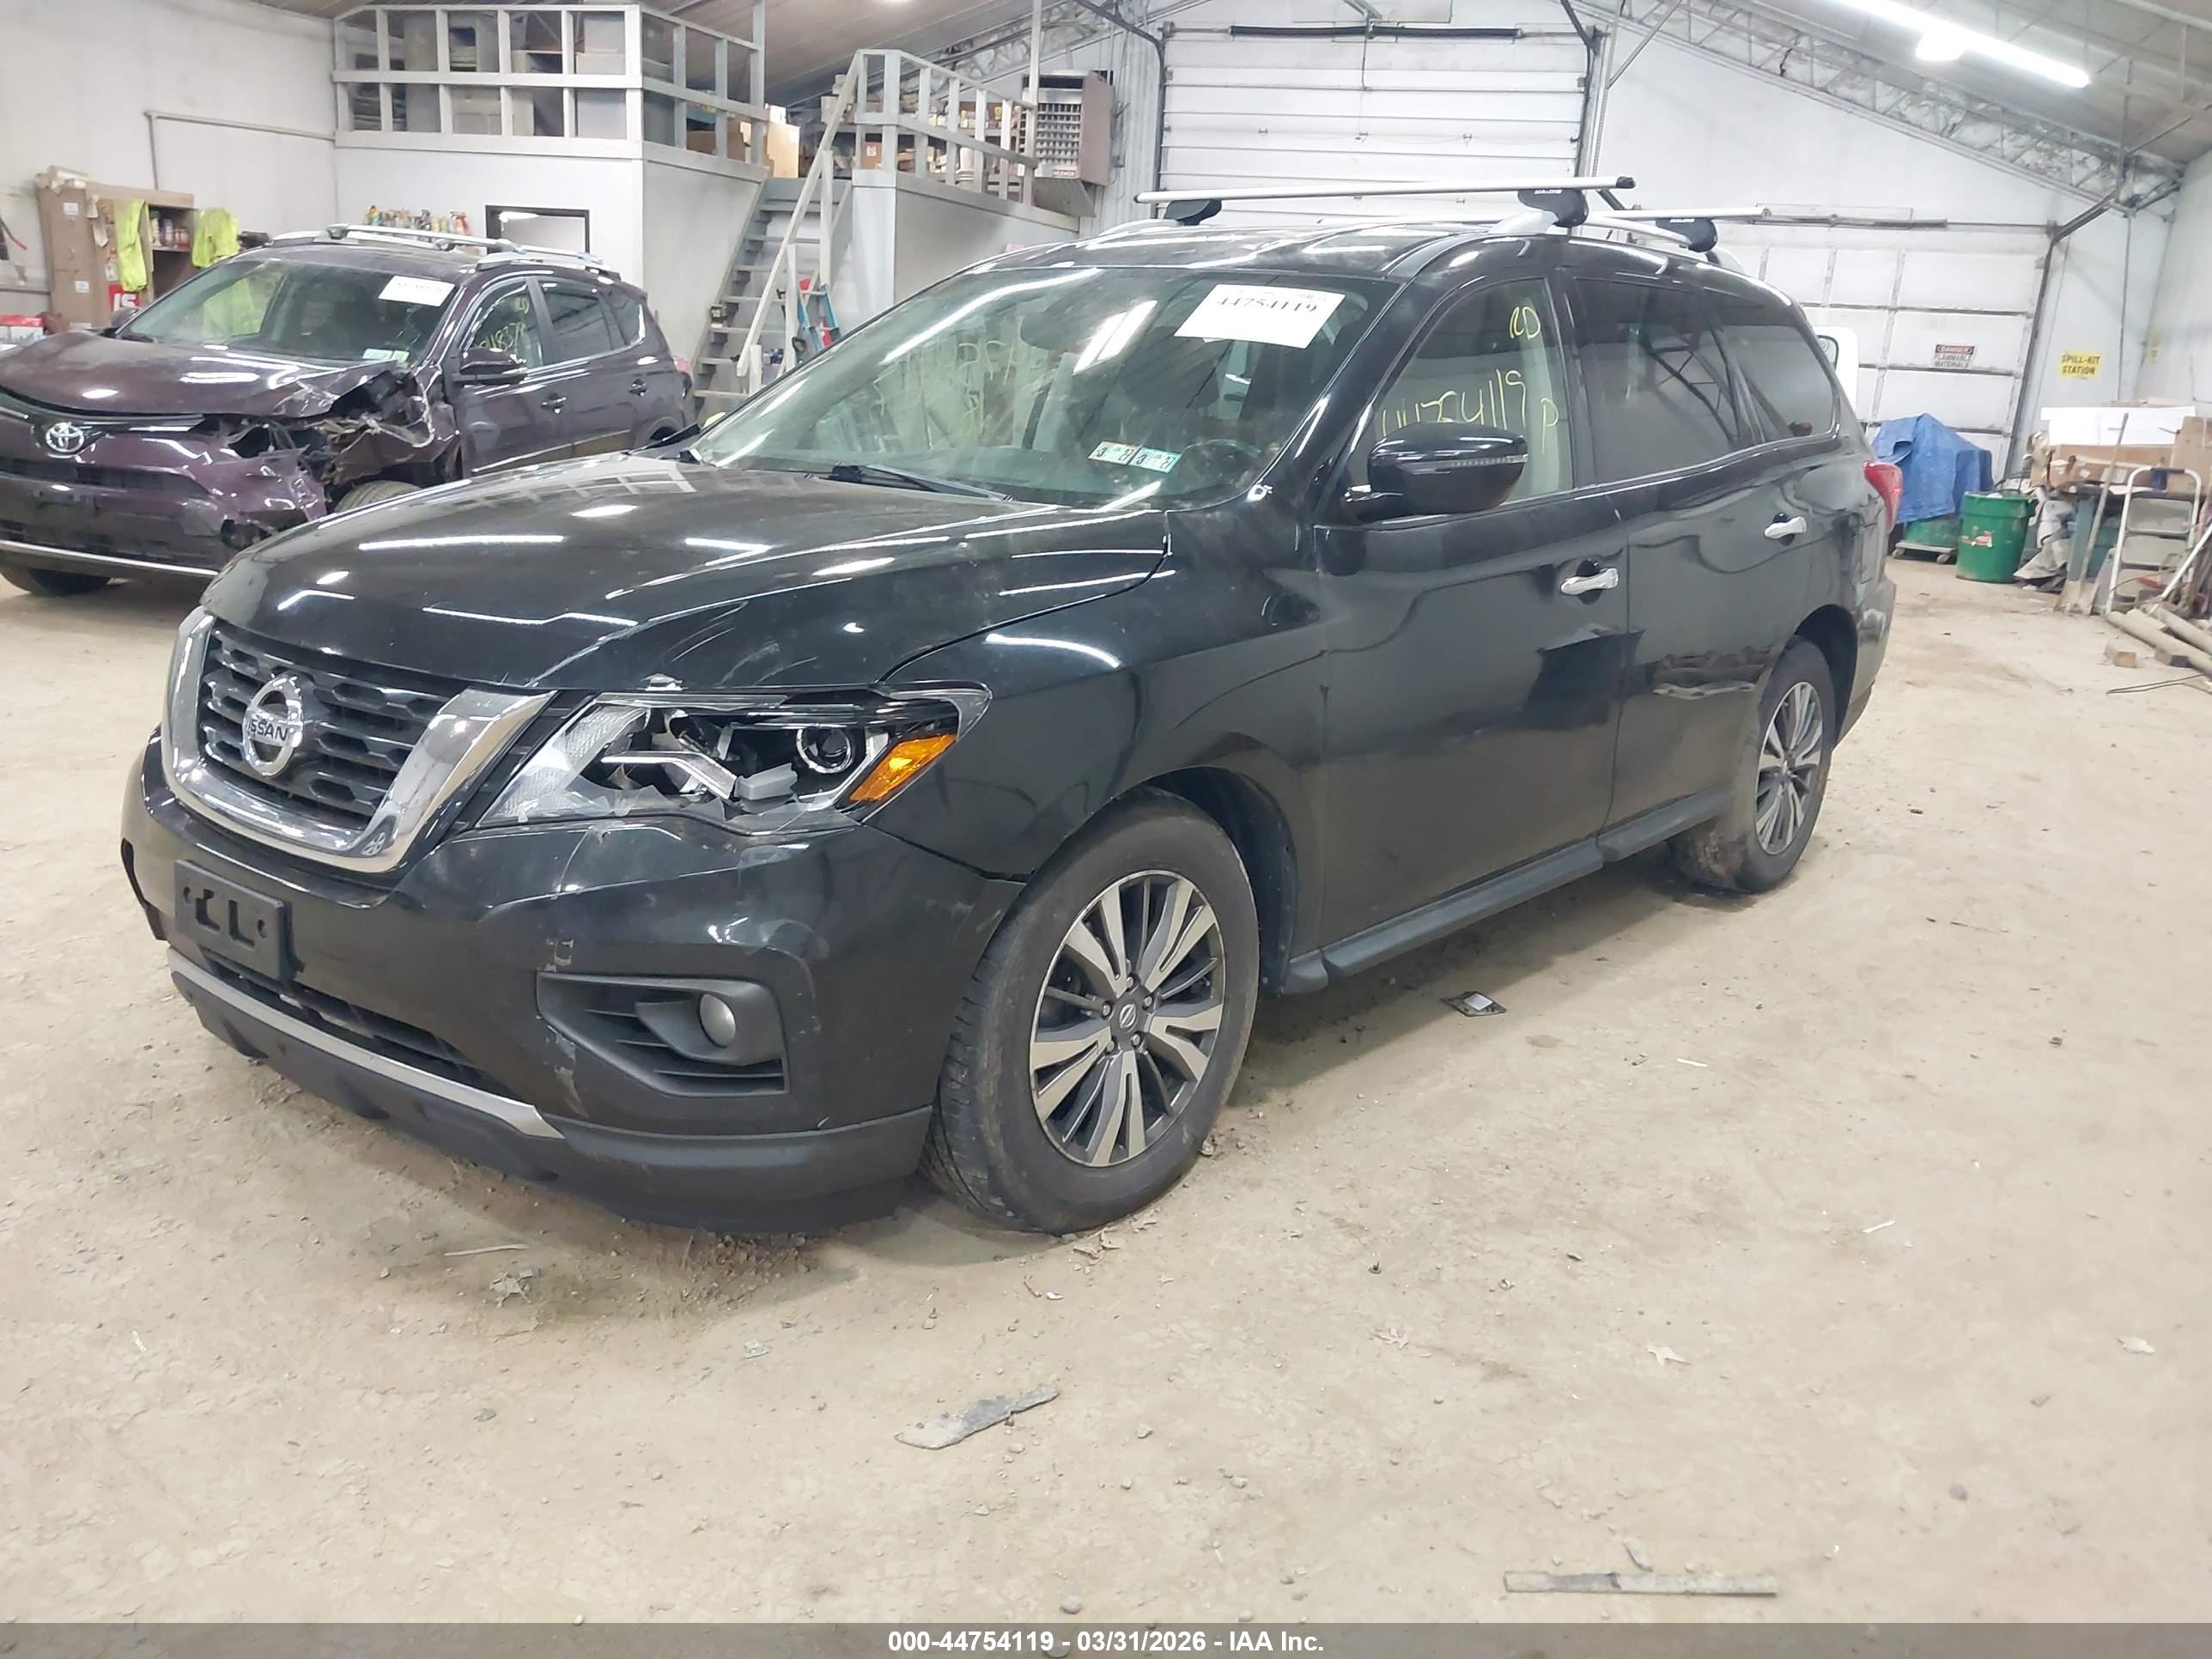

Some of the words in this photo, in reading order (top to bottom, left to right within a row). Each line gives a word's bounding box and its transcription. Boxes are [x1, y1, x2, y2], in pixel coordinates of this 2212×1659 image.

[1217, 296, 1318, 313] 44754119
[2061, 354, 2100, 365] SPILL-KIT
[2062, 365, 2096, 375] STATION
